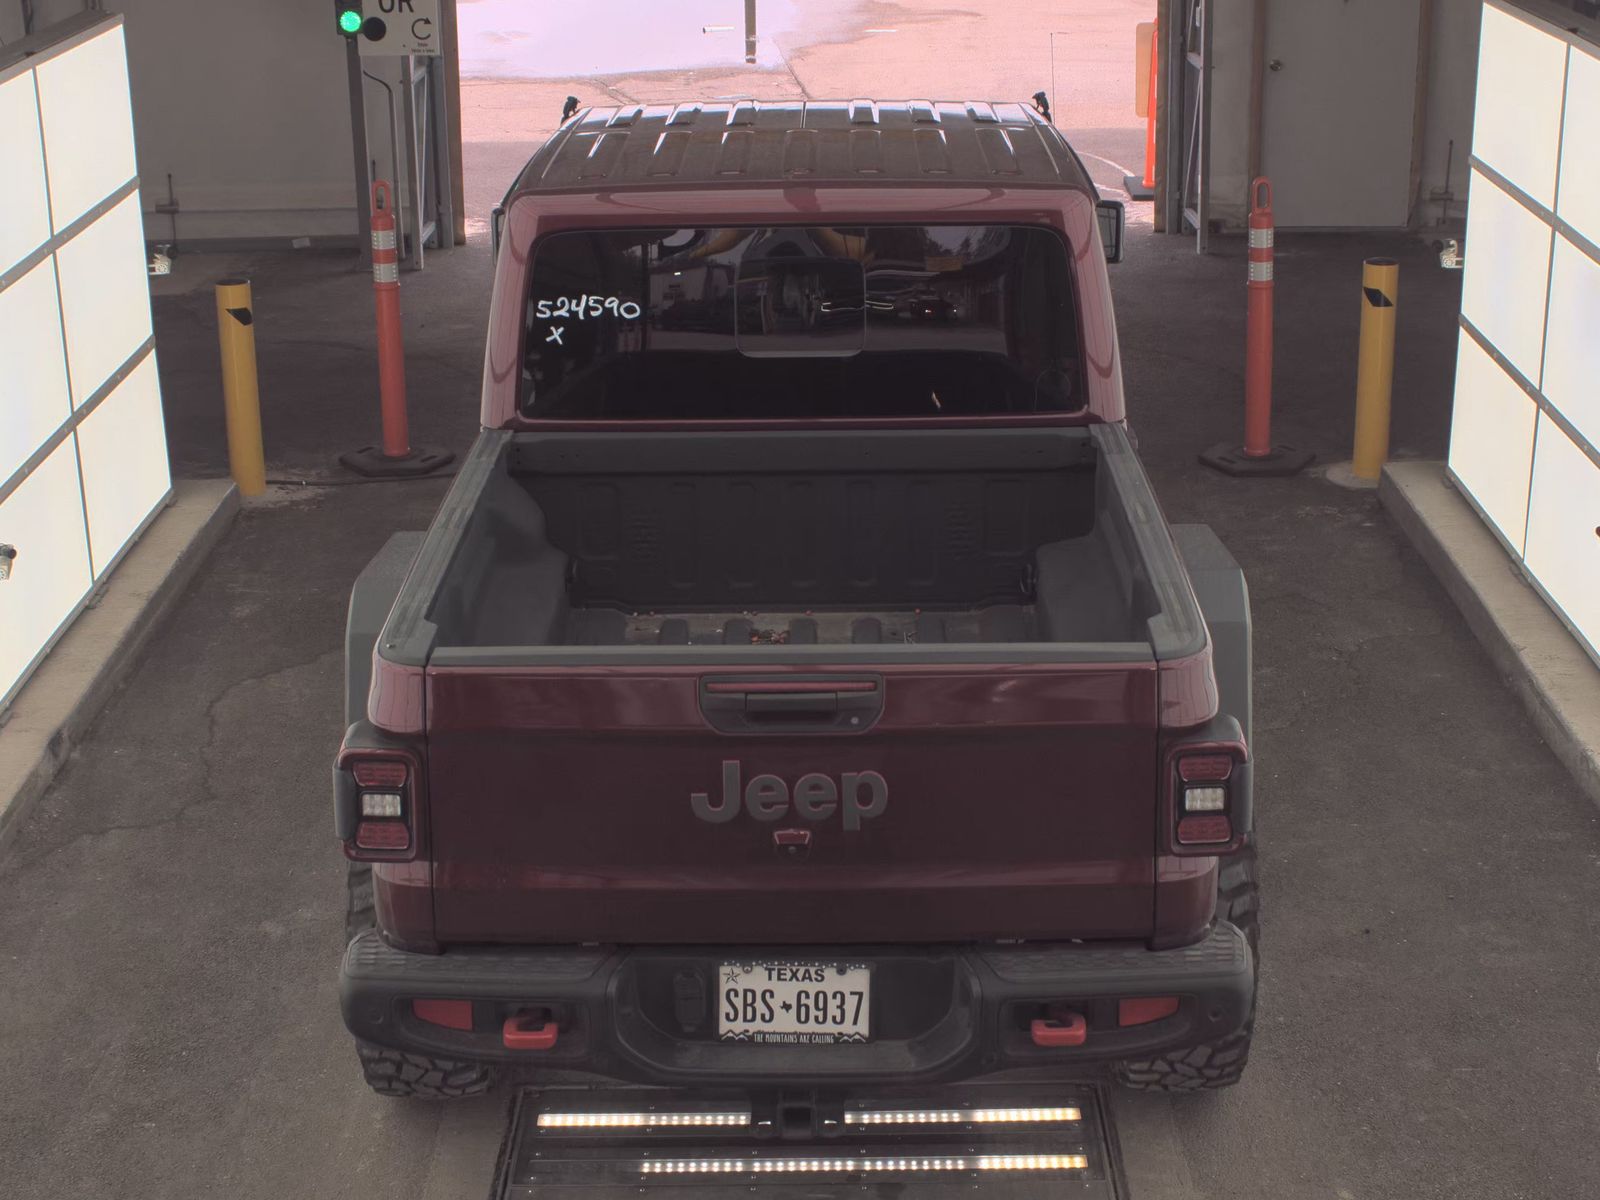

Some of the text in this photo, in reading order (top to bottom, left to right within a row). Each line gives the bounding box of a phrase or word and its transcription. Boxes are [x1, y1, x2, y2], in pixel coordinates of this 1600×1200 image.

[536, 294, 641, 320] 524590
[690, 759, 889, 831] Jeep
[765, 967, 826, 983] TEXAS
[725, 988, 865, 1026] SBS 6937
[765, 1033, 798, 1044] MOUNTAINS
[812, 1034, 834, 1044] CALLING
